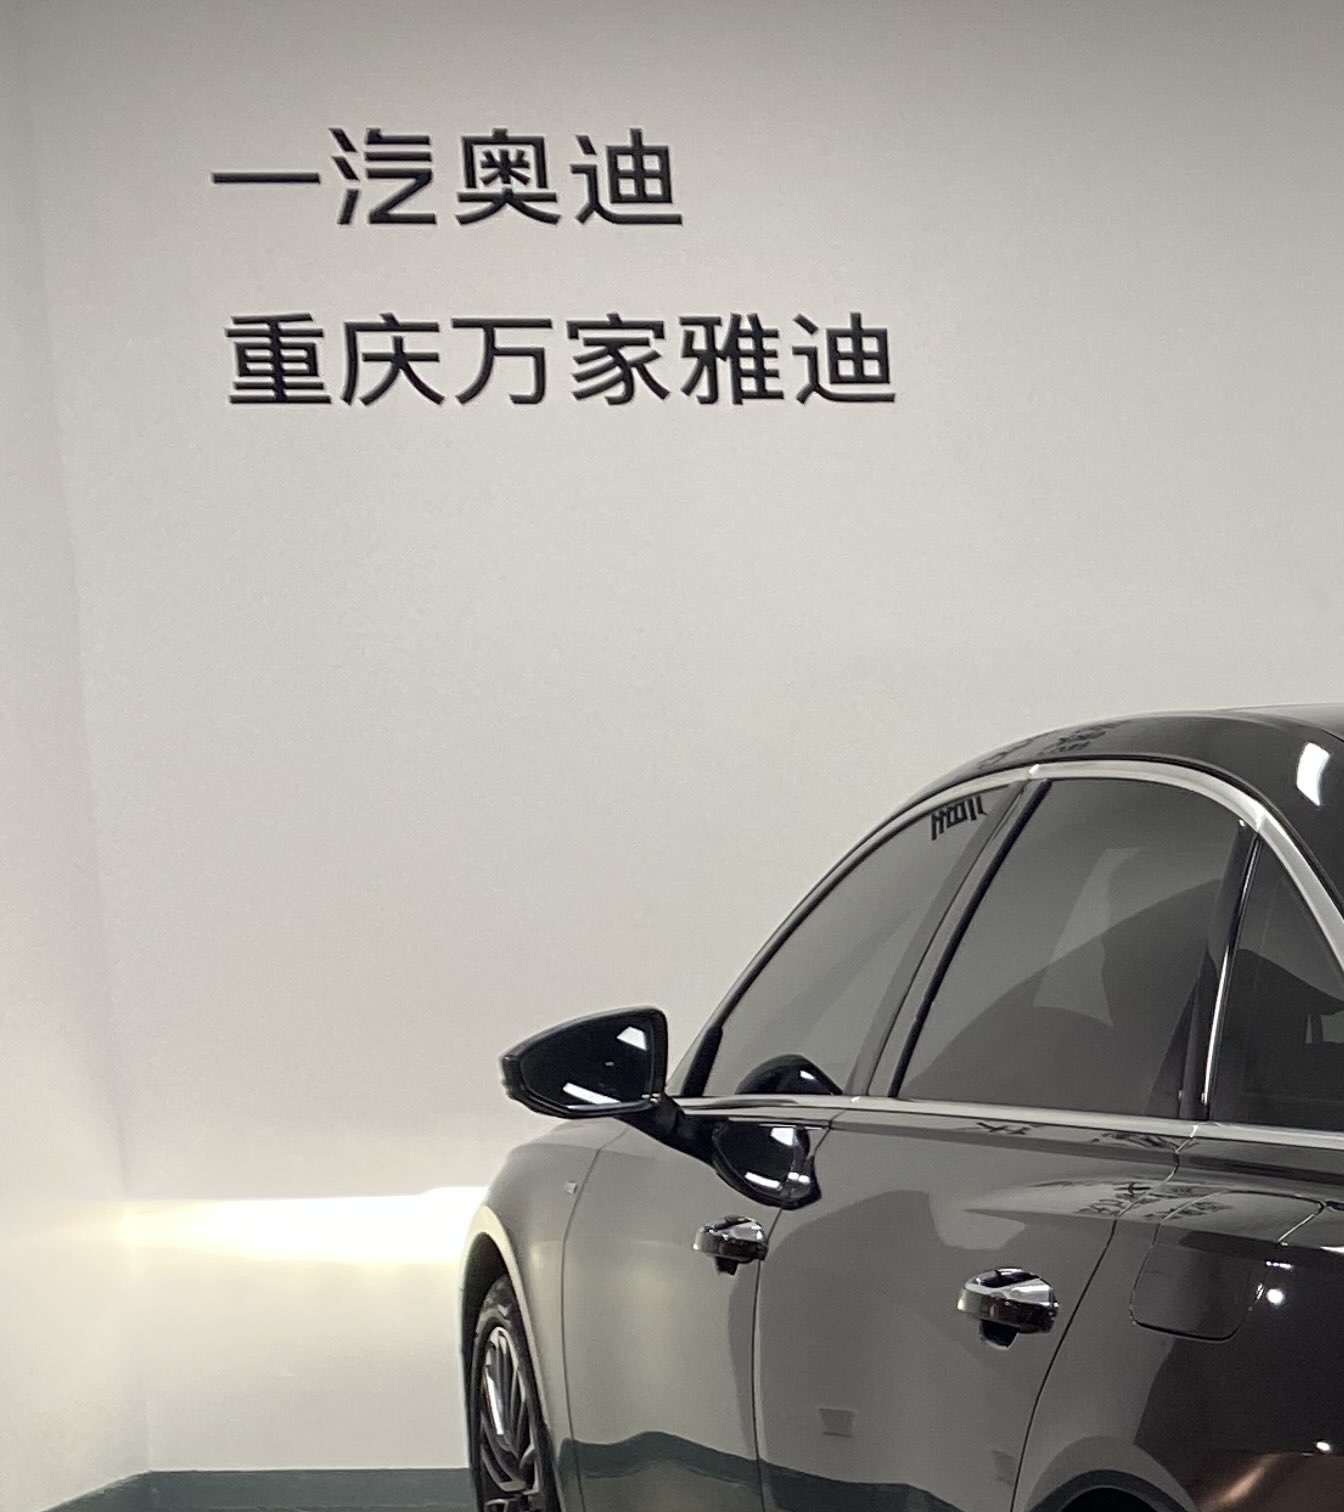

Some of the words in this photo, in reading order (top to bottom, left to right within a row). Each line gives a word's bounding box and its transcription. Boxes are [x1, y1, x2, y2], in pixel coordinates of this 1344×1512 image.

[211, 127, 683, 226] 一汽奥迪
[225, 312, 896, 406] 重庆万家雅迪
